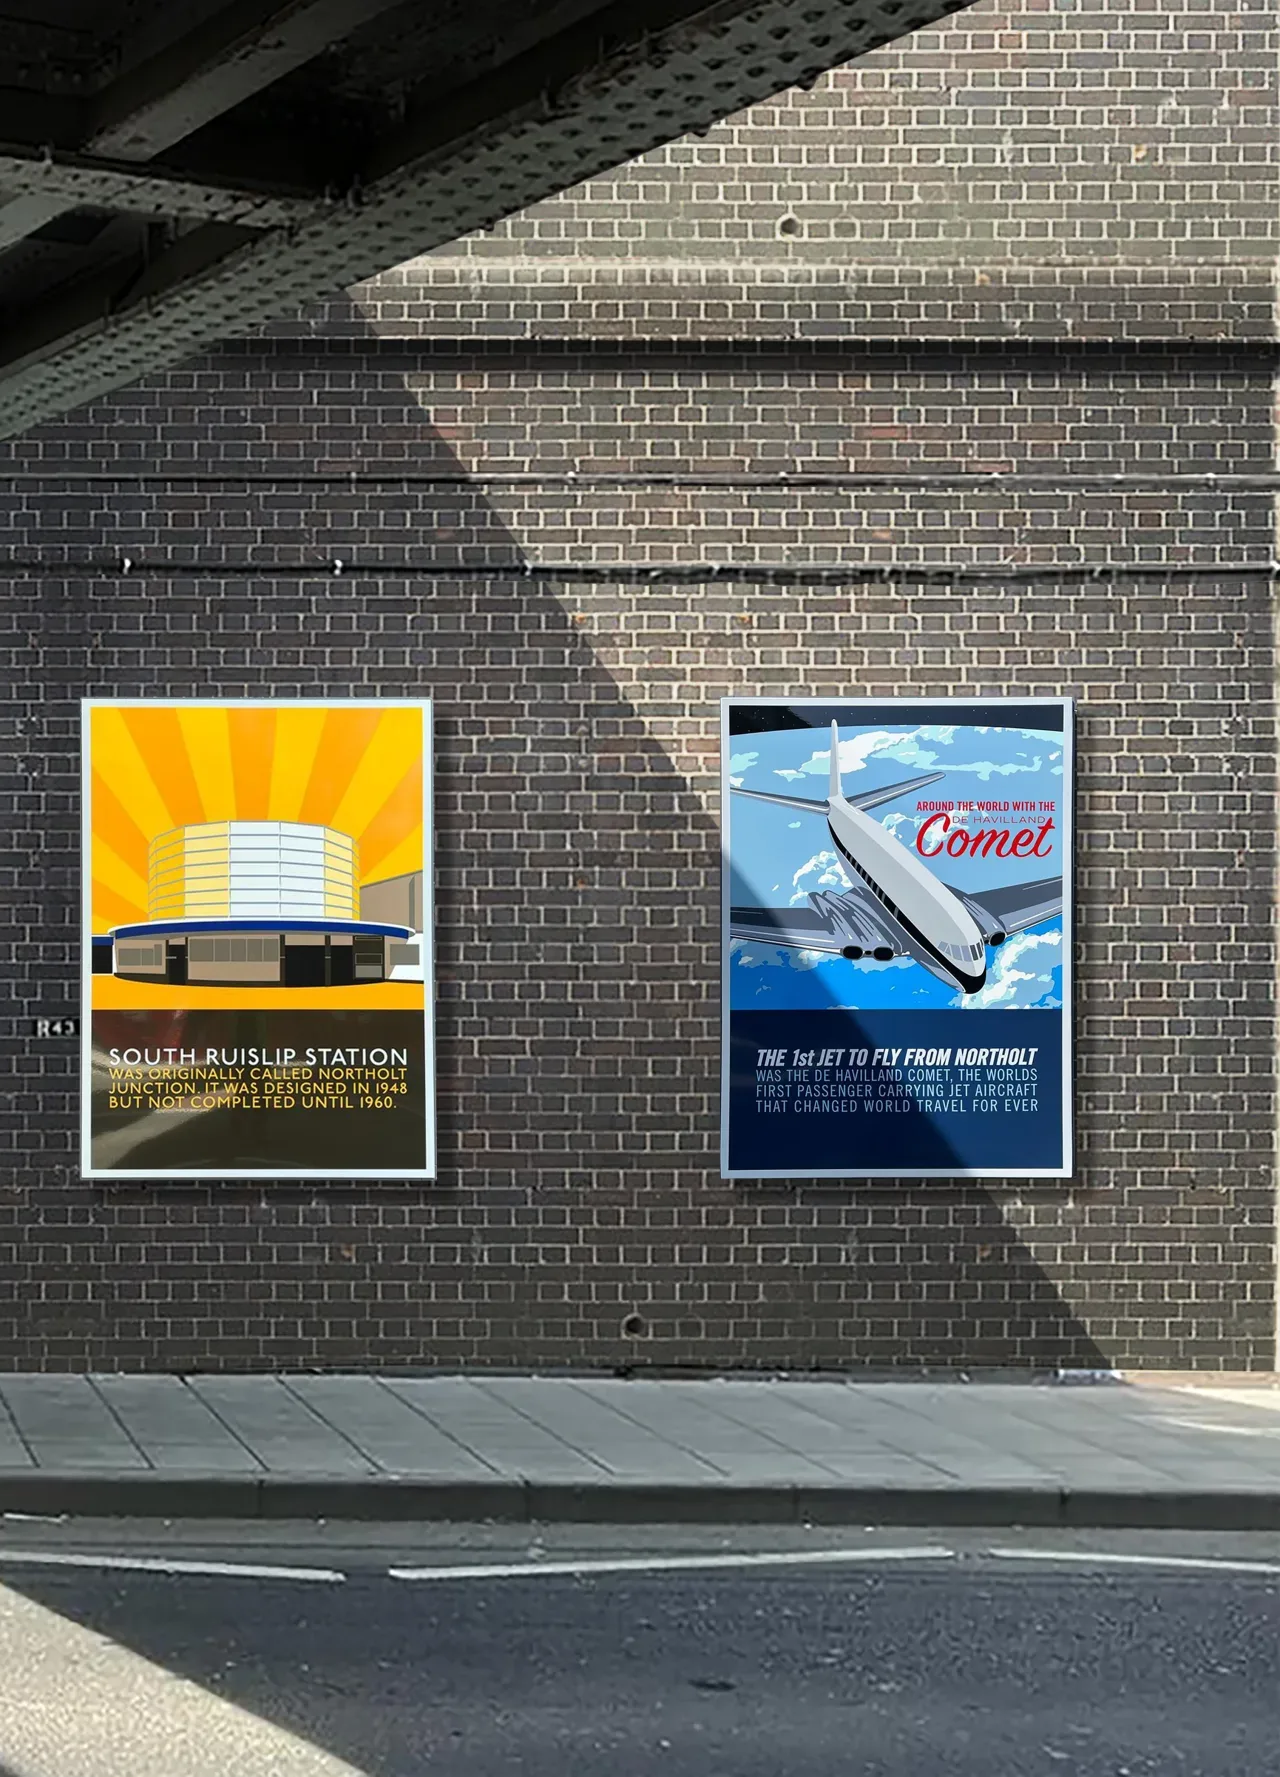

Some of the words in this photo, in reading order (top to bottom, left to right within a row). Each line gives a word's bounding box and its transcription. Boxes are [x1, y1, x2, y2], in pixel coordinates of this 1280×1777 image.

[917, 802, 954, 811] AROUND
[958, 802, 973, 811] THE
[977, 802, 1009, 811] WORLD
[1013, 802, 1035, 811] WITH
[1039, 802, 1055, 811] THE
[916, 813, 1055, 857] Comet
[109, 1048, 196, 1065] SOUTH
[207, 1048, 296, 1065] RUISLIP
[305, 1048, 407, 1065] STATION
[757, 1048, 788, 1067] THE
[793, 1048, 814, 1067] 1st
[817, 1048, 845, 1067] JET
[849, 1048, 867, 1067] TO
[872, 1048, 901, 1067] FLY
[904, 1048, 950, 1067] FROM
[954, 1048, 1038, 1067] NORTHOLT
[109, 1068, 143, 1080] WAS
[149, 1068, 245, 1080] ORIGINALLY
[250, 1068, 312, 1080] CALLED
[319, 1068, 407, 1080] NORTHOLT
[756, 1069, 782, 1082] WAS
[787, 1069, 809, 1082] THE
[815, 1069, 831, 1082] DE
[836, 1069, 902, 1082] HAVILLAND
[907, 1069, 953, 1083] COMET,
[959, 1069, 981, 1082] THE
[986, 1069, 1038, 1082] WORLDS
[109, 1082, 200, 1094] JUNCTION.
[205, 1082, 220, 1094] IT
[223, 1082, 258, 1094] WAS
[265, 1082, 346, 1094] DESIGNED
[353, 1082, 369, 1094] IN
[376, 1082, 407, 1094] 1948
[756, 1084, 792, 1097] FIRST
[797, 1084, 872, 1097] PASSENGER
[878, 1084, 944, 1097] CARRYING
[949, 1084, 970, 1097] JET
[975, 1084, 1037, 1097] AIRCRAFT
[110, 1096, 140, 1108] BUT
[149, 1096, 184, 1108] NOT
[191, 1096, 295, 1108] COMPLETED
[302, 1096, 353, 1108] UNTIL
[360, 1096, 397, 1108] 1960.
[756, 1100, 787, 1112] THAT
[794, 1100, 857, 1112] CHANGED
[863, 1100, 910, 1112] WORLD
[917, 1100, 966, 1112] TRAVEL
[973, 1100, 997, 1112] FOR
[1005, 1100, 1038, 1112] EVER
